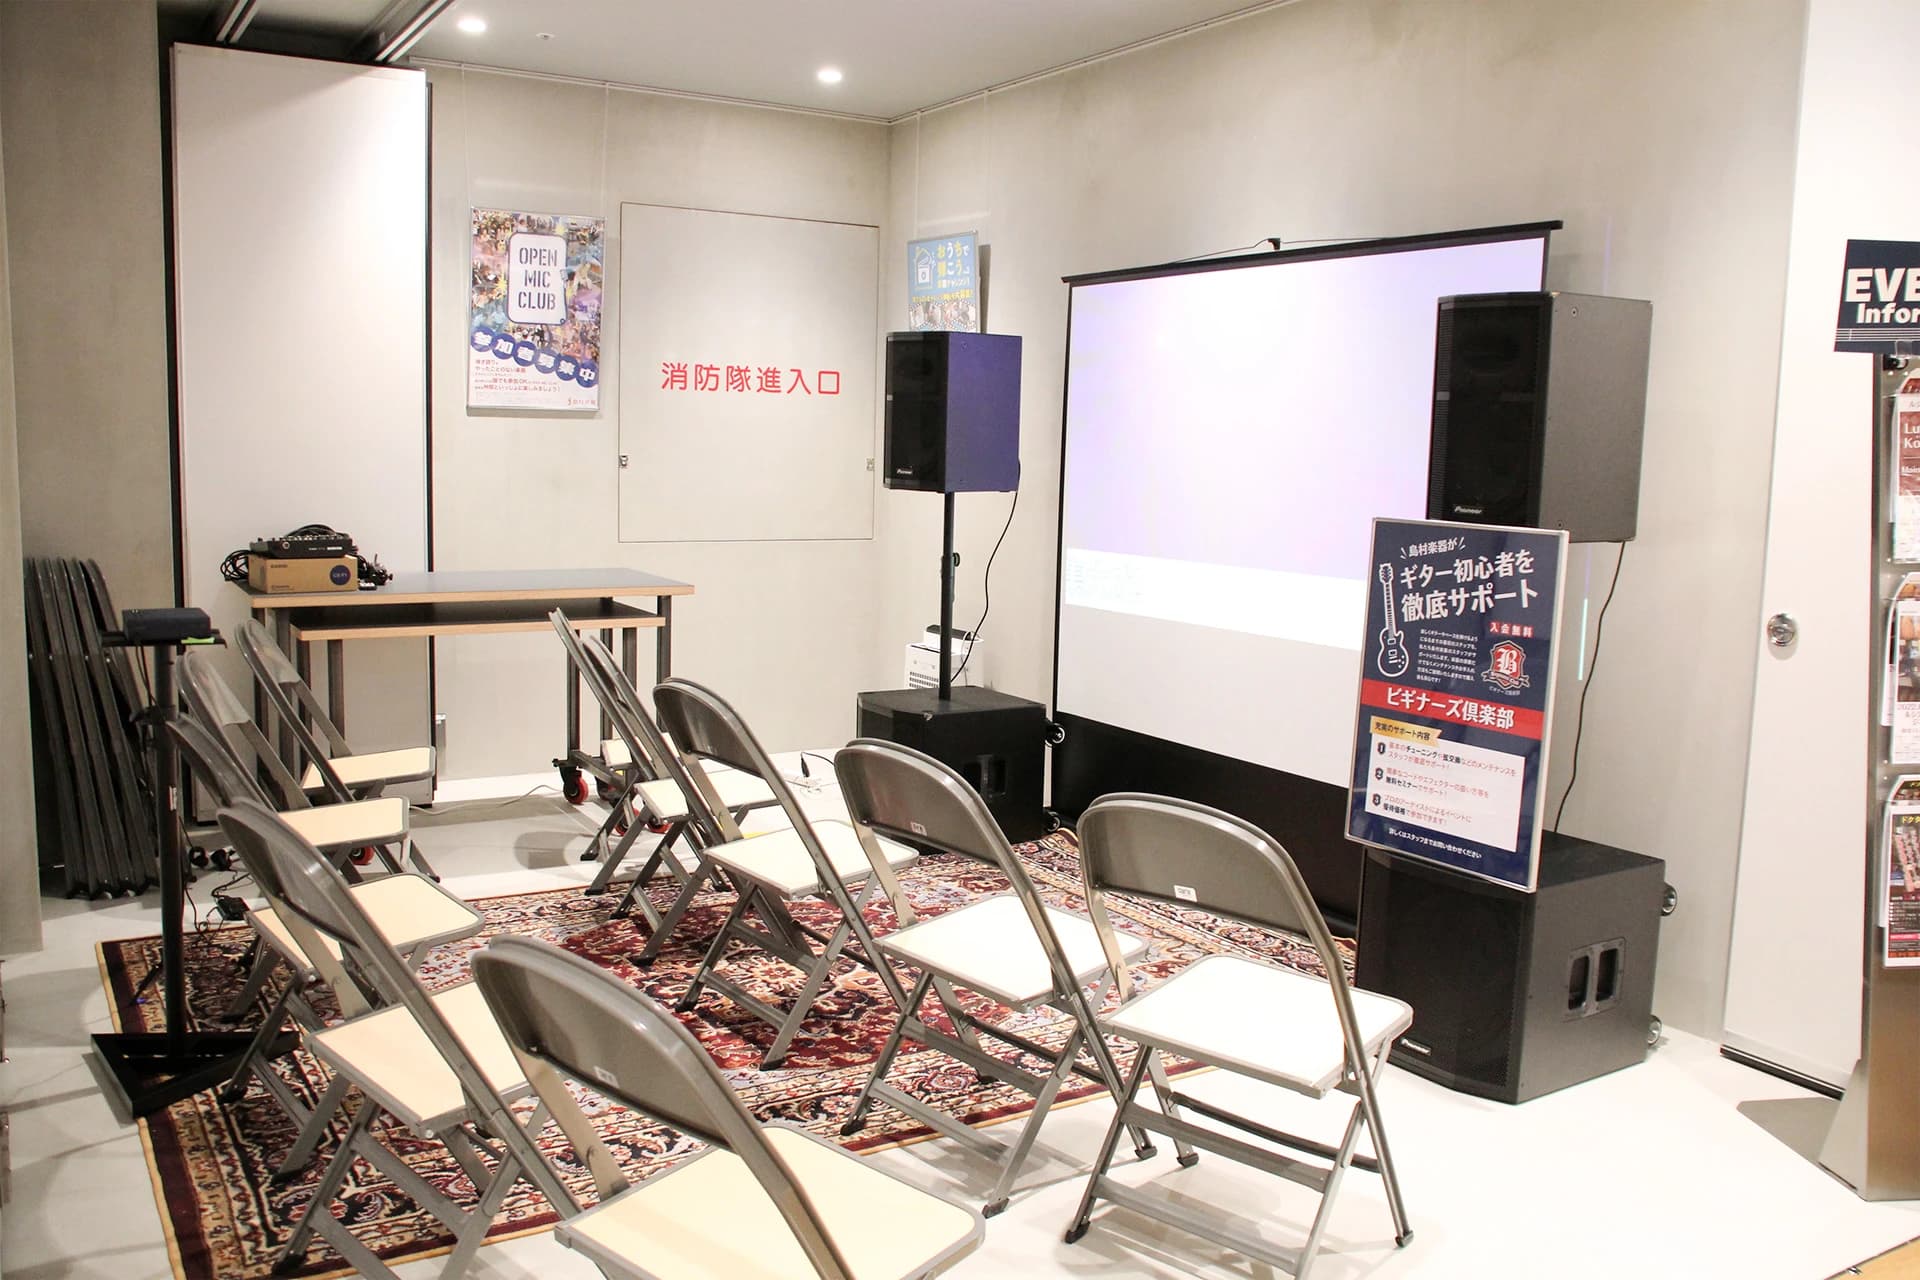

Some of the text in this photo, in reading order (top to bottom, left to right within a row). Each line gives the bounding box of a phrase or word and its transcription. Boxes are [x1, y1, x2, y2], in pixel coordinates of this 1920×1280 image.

[519, 247, 557, 267] OPEN
[524, 270, 551, 288] MIC
[518, 291, 556, 310] CLUB
[661, 362, 840, 395] 消防隊進入口
[1408, 537, 1459, 558] 島村楽器が
[1400, 548, 1536, 589] ギター初心者を
[1401, 578, 1539, 623] 徹底サポート
[1489, 621, 1534, 638] 入会無料
[1387, 686, 1515, 730] ビギナーズ倶楽部
[1374, 721, 1431, 741] 充実のサポート内容
